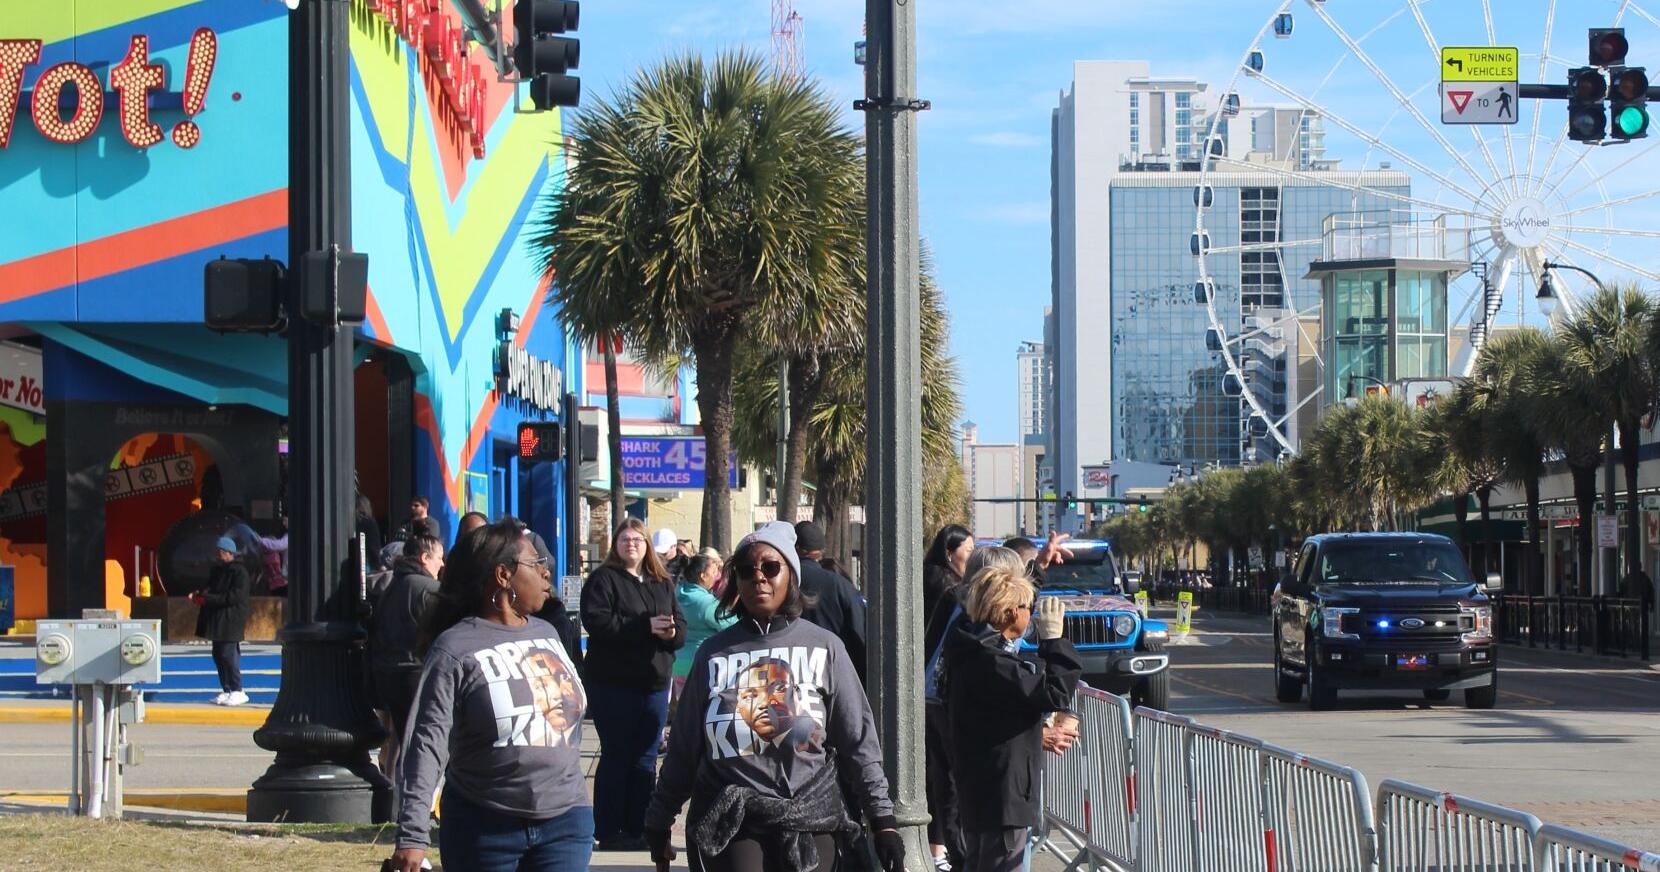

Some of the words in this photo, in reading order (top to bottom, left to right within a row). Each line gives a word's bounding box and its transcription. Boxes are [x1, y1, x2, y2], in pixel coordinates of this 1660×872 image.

[1468, 53, 1512, 62] TURNING
[1467, 67, 1513, 76] VEHICLES
[1476, 98, 1490, 108] TO
[1503, 217, 1550, 230] SkyWheel
[507, 338, 530, 401] SUPER
[529, 354, 544, 411] FUN
[705, 682, 824, 723] LE
